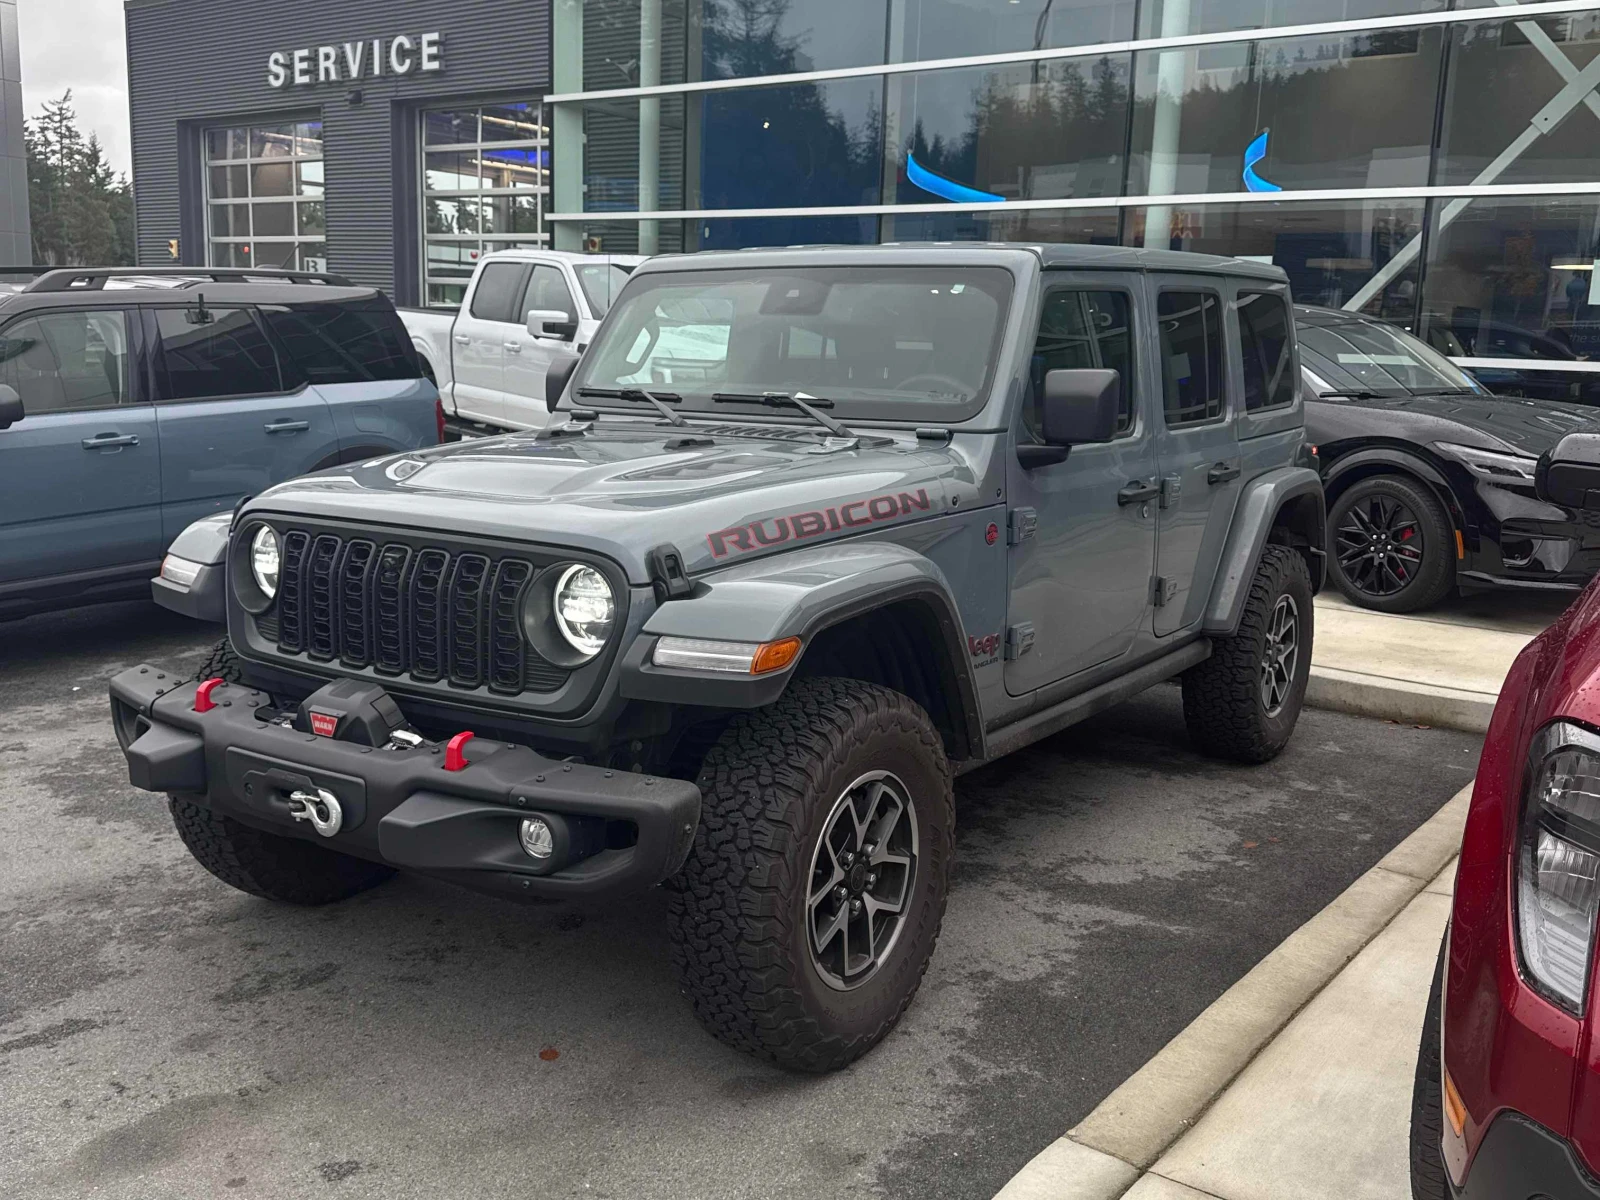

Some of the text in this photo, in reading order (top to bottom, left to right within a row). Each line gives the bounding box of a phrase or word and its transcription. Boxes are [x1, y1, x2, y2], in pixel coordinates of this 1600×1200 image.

[267, 32, 442, 88] SERVICE
[706, 488, 931, 559] RUBICON
[314, 720, 333, 731] WARN
